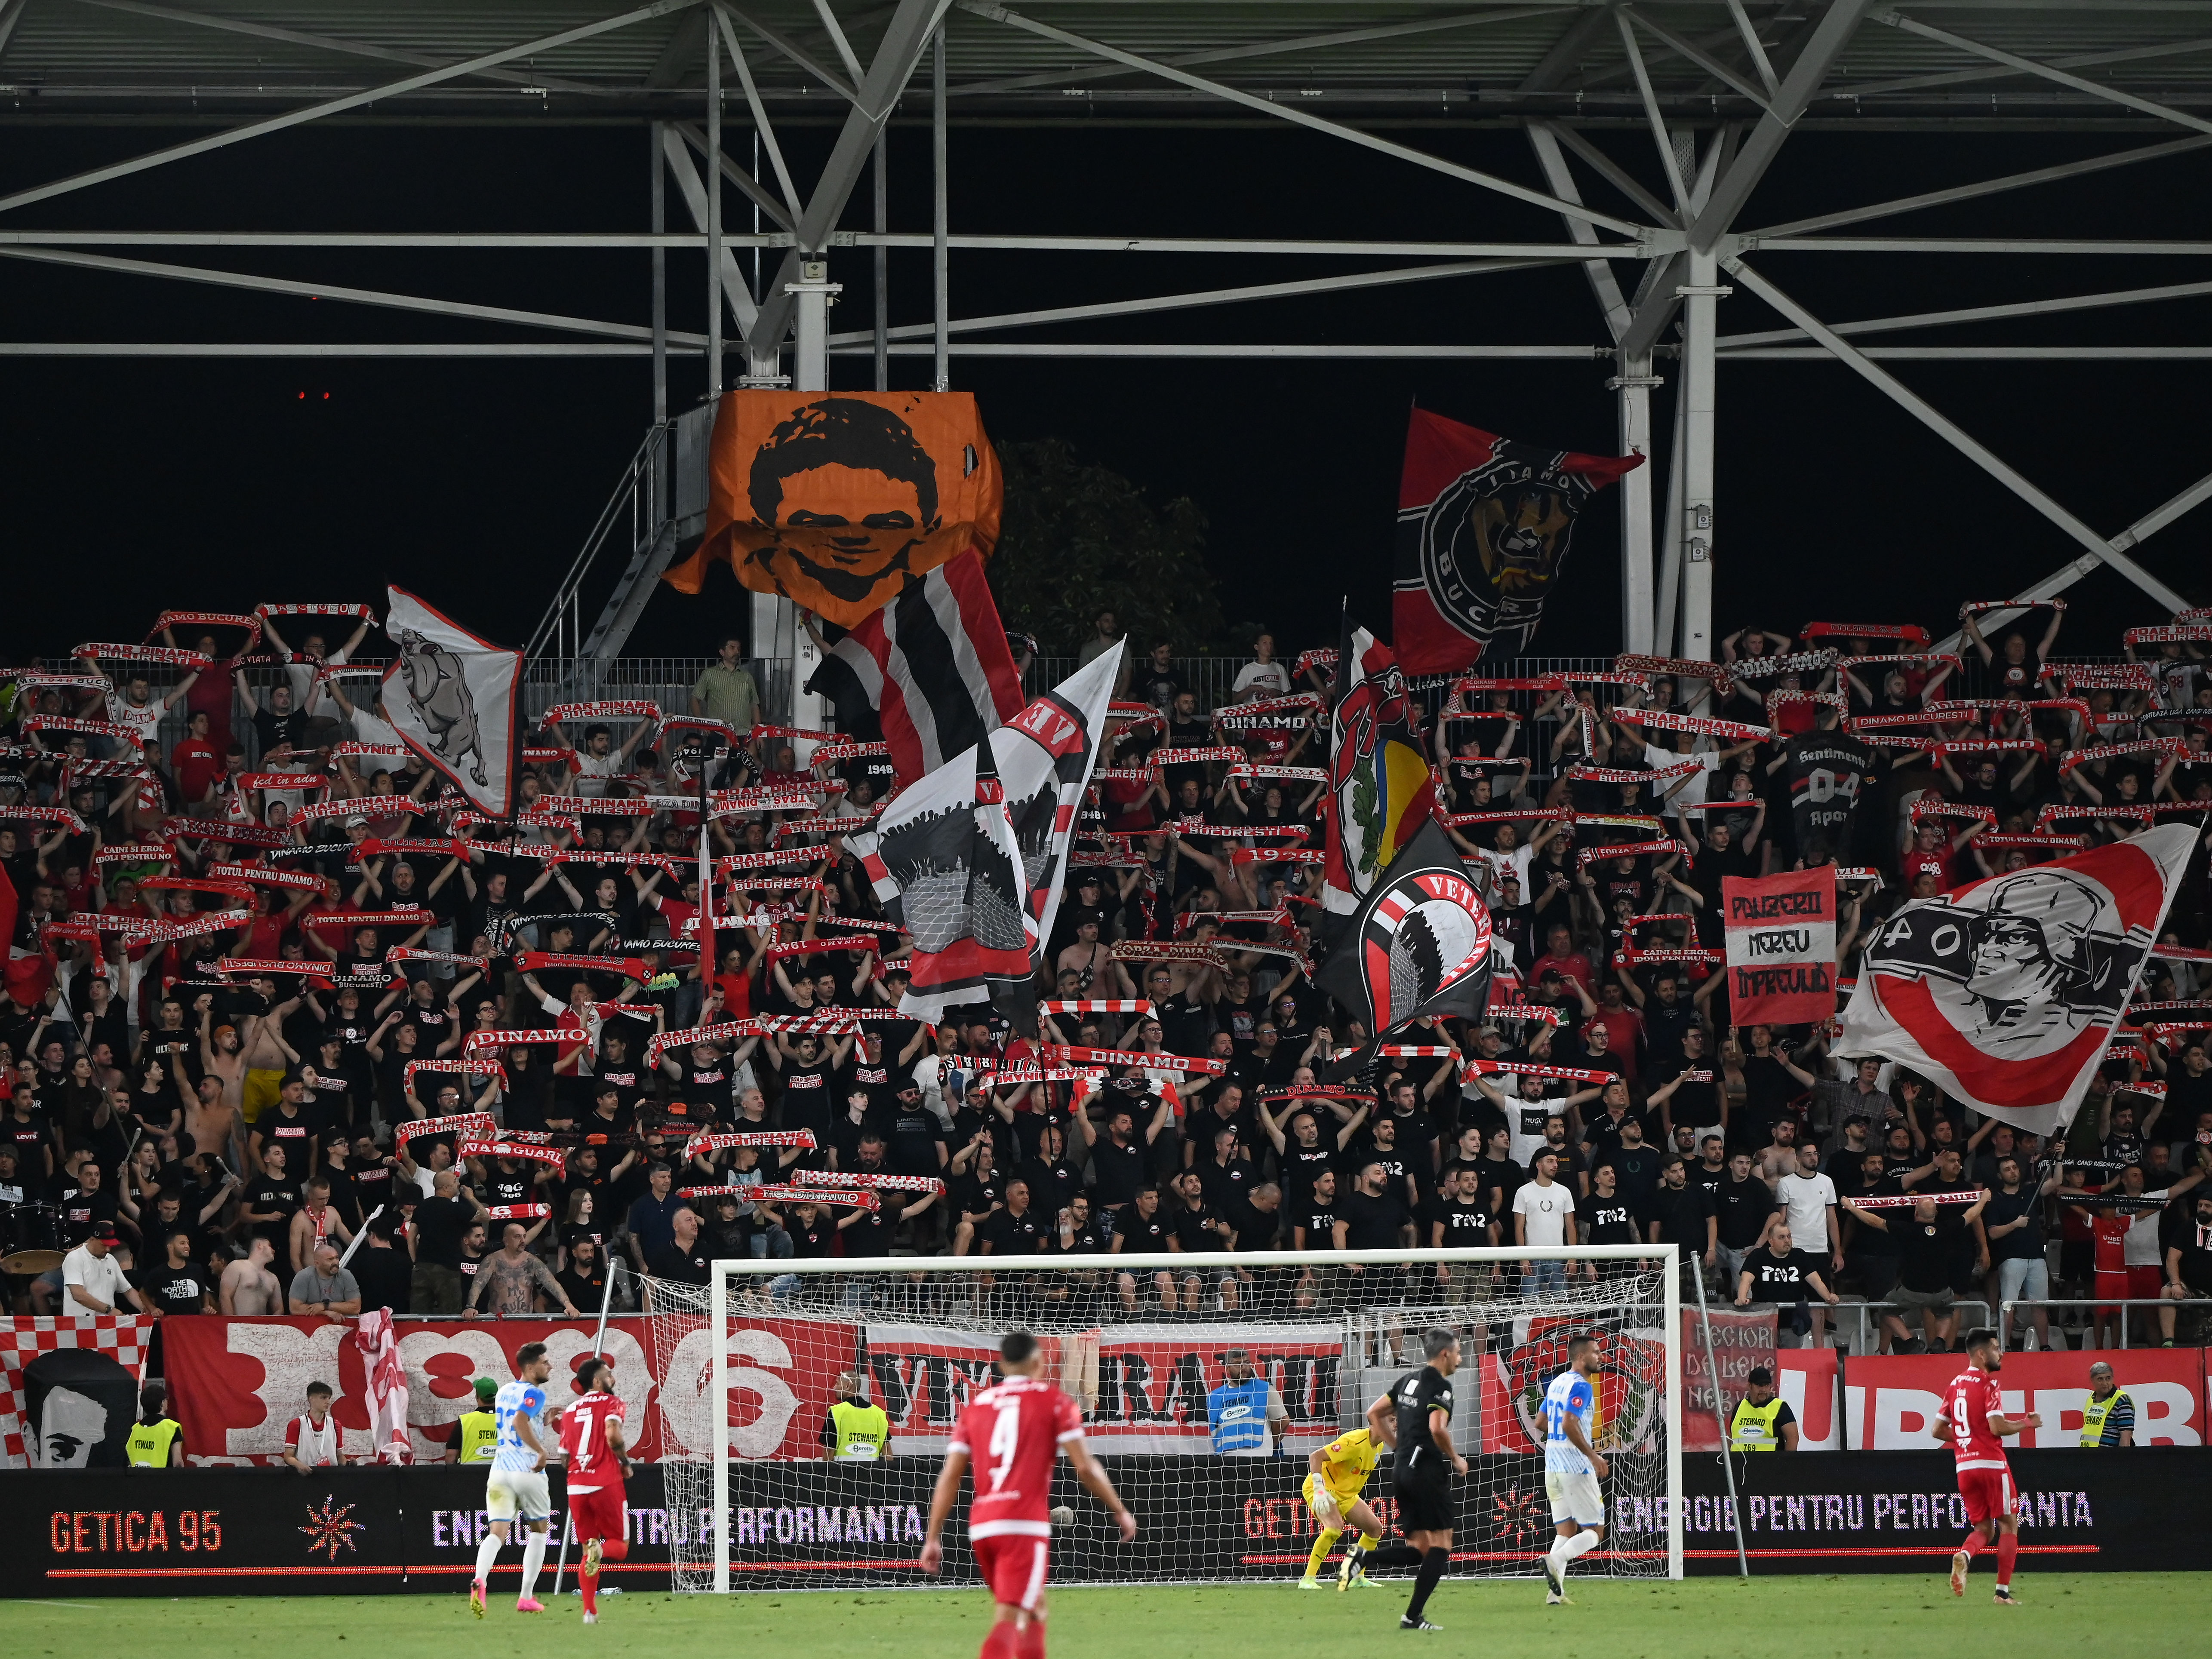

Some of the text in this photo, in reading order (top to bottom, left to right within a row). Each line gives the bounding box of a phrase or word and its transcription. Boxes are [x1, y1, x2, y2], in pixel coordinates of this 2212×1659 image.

[2129, 627, 2169, 636] DOAR
[89, 643, 200, 658] DOAR DINAMO
[98, 650, 190, 664] BUCURESTI
[2074, 682, 2151, 691] BUCURESTI
[555, 700, 658, 713] DOAR DINAMO
[562, 707, 647, 719] BUCURESTI
[1223, 716, 1305, 729] DINAMO
[1635, 710, 1747, 732] DOAR DINAMO
[1860, 711, 1968, 727] DINAMO BUCURESTI
[42, 722, 127, 739] BUCURESTI
[1643, 719, 1738, 738] BUCURESTI
[819, 744, 862, 755] DOAR
[1945, 740, 2035, 751] DINAMO
[2084, 743, 2177, 761] BUCURESTI
[868, 765, 893, 774] 1948
[1598, 769, 1683, 783] BUCURESTI
[717, 780, 833, 796] DOAR DINAMO
[298, 795, 409, 813] DOAR DINAMO
[540, 795, 648, 808] DOAR DINAMO
[306, 802, 399, 819] BUCURESTI
[549, 804, 639, 815] BUCURESTI
[1919, 807, 1987, 820] BUCURESTI
[1455, 814, 1486, 822] TOTUL
[1488, 811, 1520, 819] PENTRU
[1188, 827, 1281, 836] BUCURESTI
[380, 838, 452, 848] ULTRAS
[1989, 836, 2048, 845] TOTUL PENTRU
[271, 845, 314, 859] DINAMO
[724, 844, 831, 864] DOAR DINAMO
[1600, 841, 1672, 857] FORZA DINAMO
[731, 850, 831, 870] BUCURESTI
[216, 866, 313, 886] TOTUL PENTRU DINAMO
[735, 880, 817, 890] BUCURESTI
[348, 914, 384, 923] PENTRU
[150, 922, 225, 943] BUCURESTI
[820, 939, 864, 947] DINAMO
[1749, 929, 1810, 956] MEREU
[548, 952, 625, 965] ULTRAS
[1116, 946, 1226, 964] FORZA DINAMO
[1662, 954, 1701, 962] PENTRU
[1683, 949, 1711, 957] EROI,
[478, 1029, 586, 1044] DINAMO
[655, 1020, 757, 1042] DOAR DINAMO
[663, 1028, 748, 1049] BUCURESTI
[1090, 1050, 1190, 1070] DINAMO
[415, 1063, 499, 1073] BUCURESTI
[1496, 1063, 1591, 1078] DINAMO
[1286, 1084, 1345, 1097] DINAMO
[400, 1112, 492, 1133] DOAR DINAMO
[408, 1121, 485, 1139] BUCURESTI
[702, 1134, 743, 1143] DOAR
[711, 1137, 797, 1149] BUCURESTI
[794, 1190, 858, 1203] DINAMO
[162, 1285, 187, 1294] NORTH
[1222, 1395, 1249, 1407] STEWARD
[1226, 1406, 1246, 1418] Beretta
[1954, 1397, 1971, 1438] 9
[1738, 1417, 1766, 1427] STEWARD
[574, 1414, 594, 1457] 7
[848, 1432, 878, 1443] STEWARD
[1750, 1491, 2093, 1532] PENTRU PERFOANTA
[51, 1510, 222, 1553] GETICA 95
